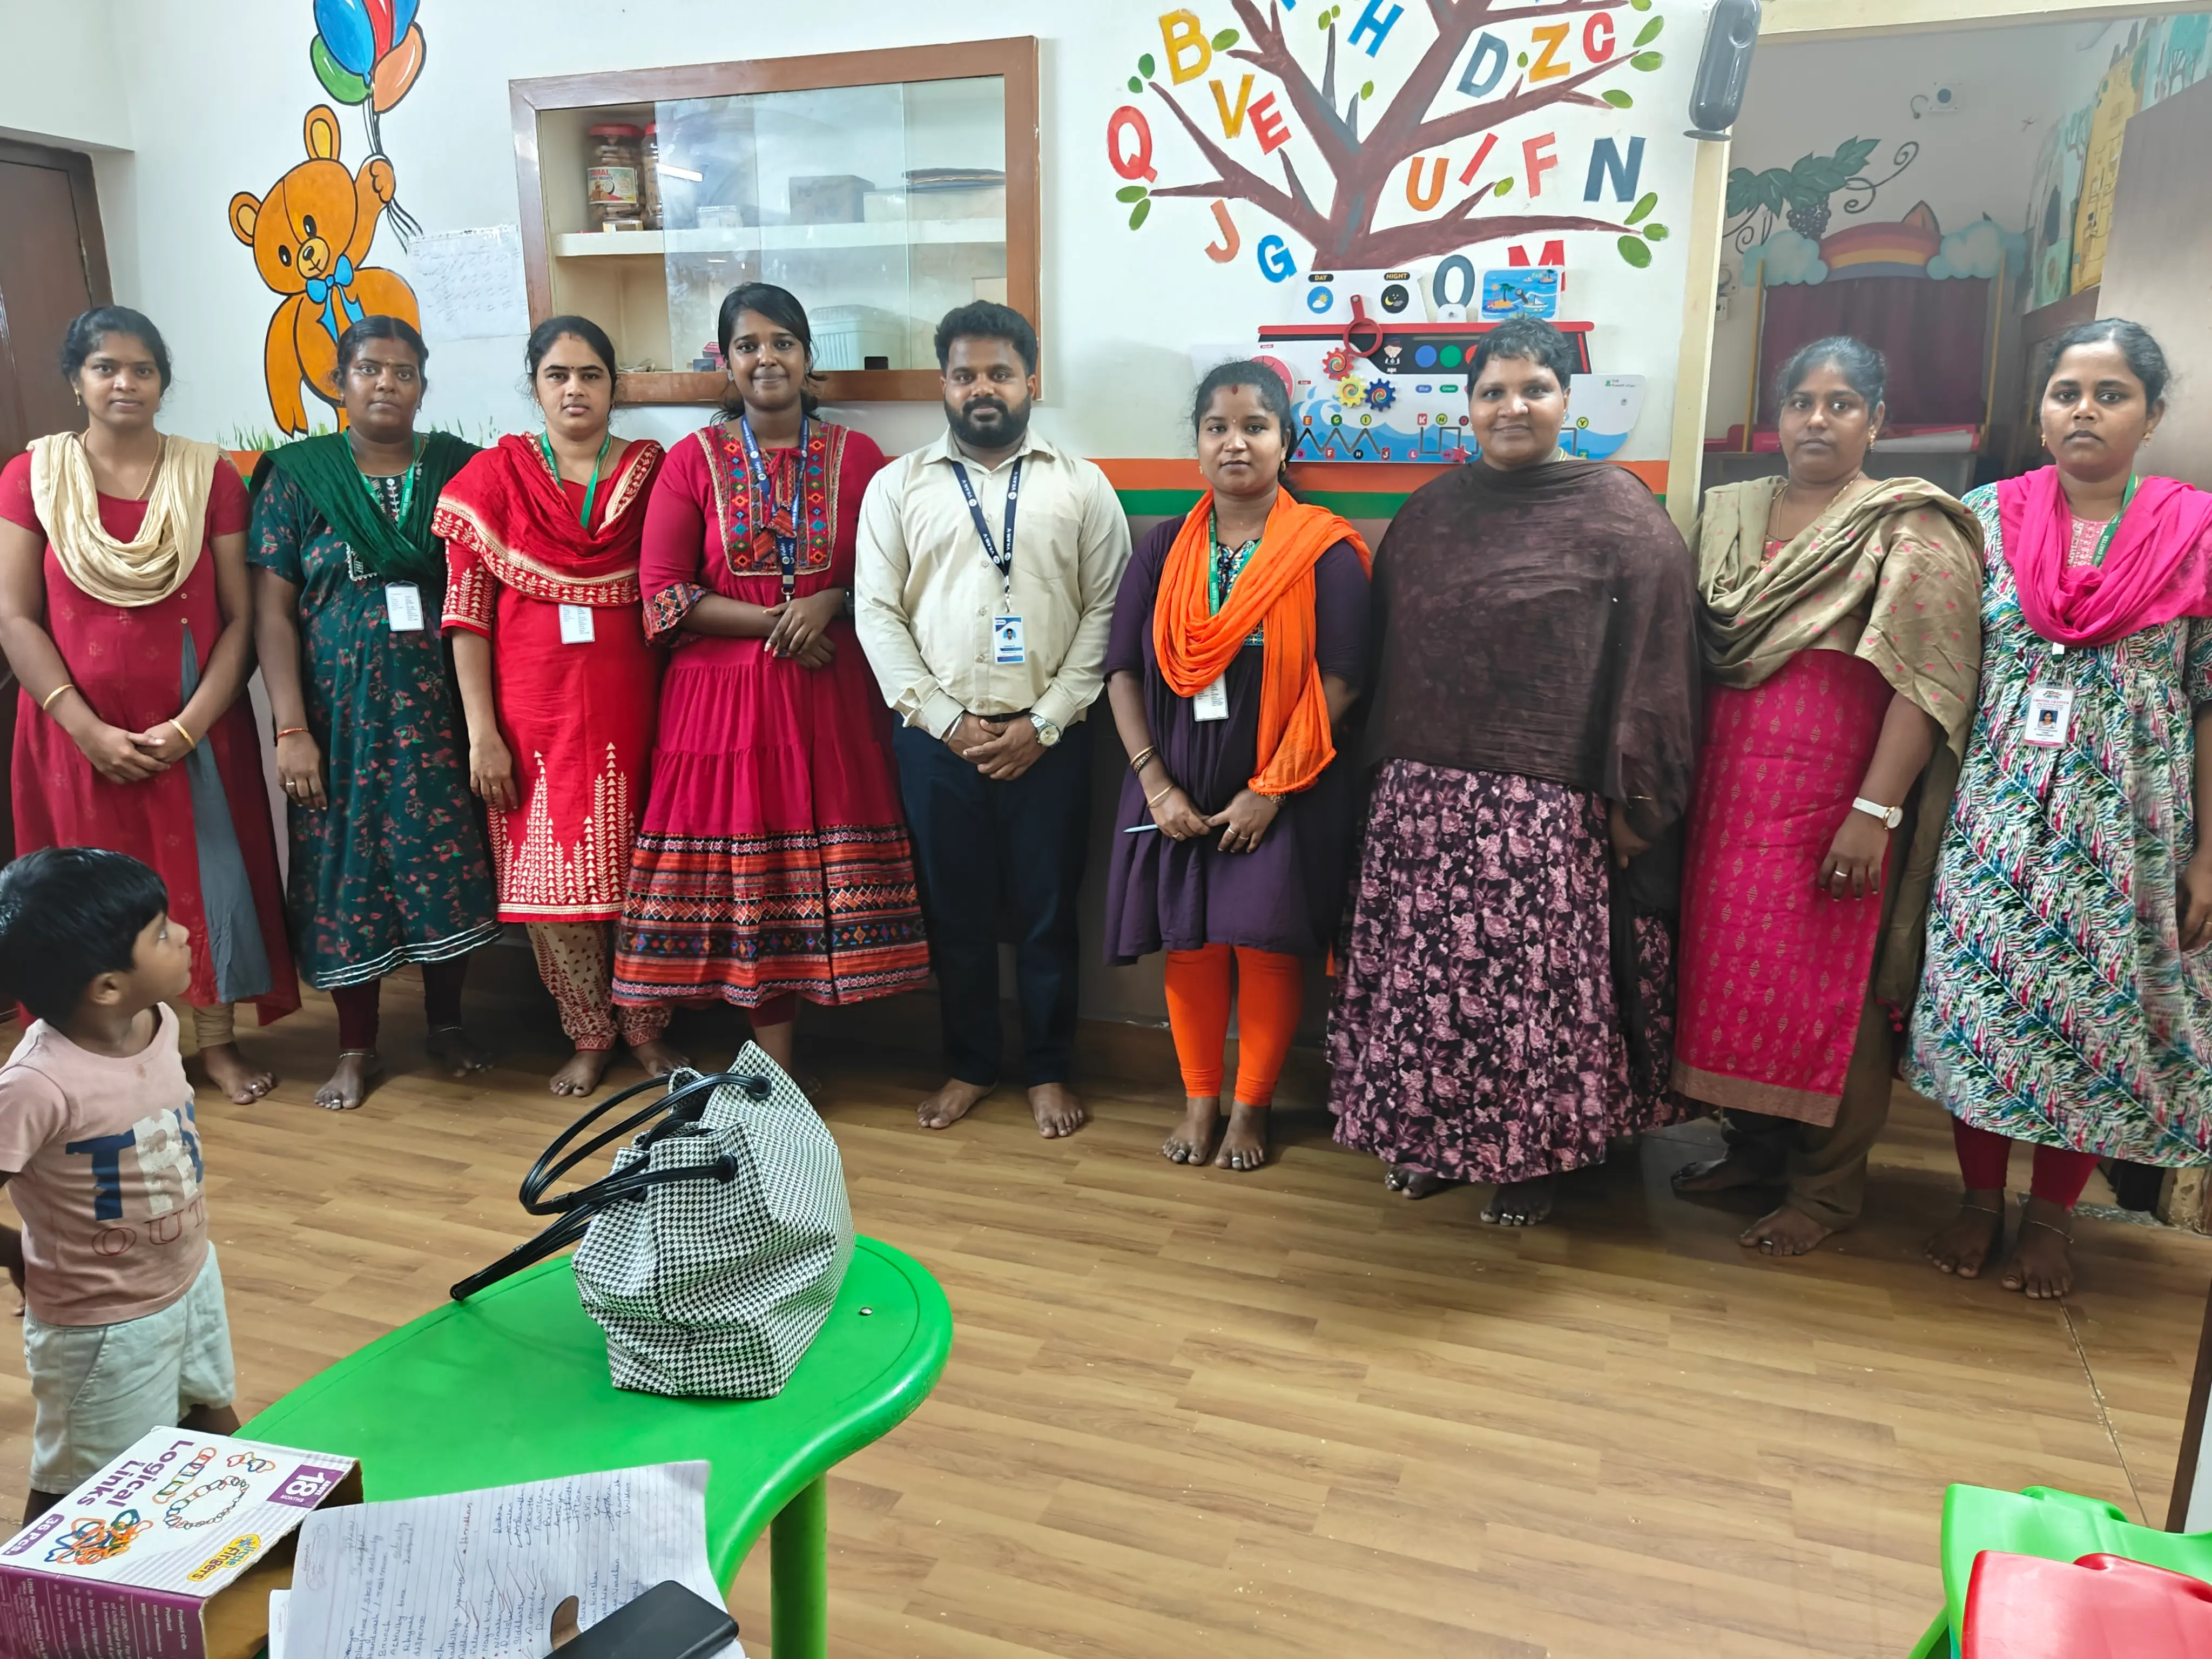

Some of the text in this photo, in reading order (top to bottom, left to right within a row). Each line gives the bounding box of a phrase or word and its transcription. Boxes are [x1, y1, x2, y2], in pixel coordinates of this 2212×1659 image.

[1159, 9, 1212, 86] B
[1347, 0, 1404, 58] H
[1529, 22, 1570, 83] Z
[1583, 12, 1615, 63] C
[1456, 31, 1509, 98] D
[1209, 74, 1256, 139] V
[1246, 91, 1293, 156] E
[1106, 105, 1158, 184] Q
[1459, 133, 1498, 186] I
[1522, 131, 1559, 199] F
[1583, 137, 1647, 203] N
[1405, 157, 1447, 212] U
[1204, 199, 1240, 264] J
[1257, 235, 1297, 283] G
[1432, 255, 1475, 309] O
[1419, 416, 1426, 424] K
[961, 479, 973, 499] VKAN-V
[983, 533, 995, 555] VKAN-V
[2098, 535, 2110, 555] CHATTER
[91, 1197, 206, 1256] OUT
[77, 1460, 146, 1506] Links
[105, 1440, 195, 1507] Logical
[280, 1494, 305, 1502] MONTHS
[286, 1472, 325, 1496] 18
[5, 1517, 59, 1554] 36 Pcs.
[87, 1599, 93, 1608] No
[88, 1609, 96, 1626] Sharp
[111, 1610, 119, 1625] child
[177, 1609, 185, 1633] Product
[113, 1627, 121, 1641] aged
[378, 1621, 390, 1657] Brunch
